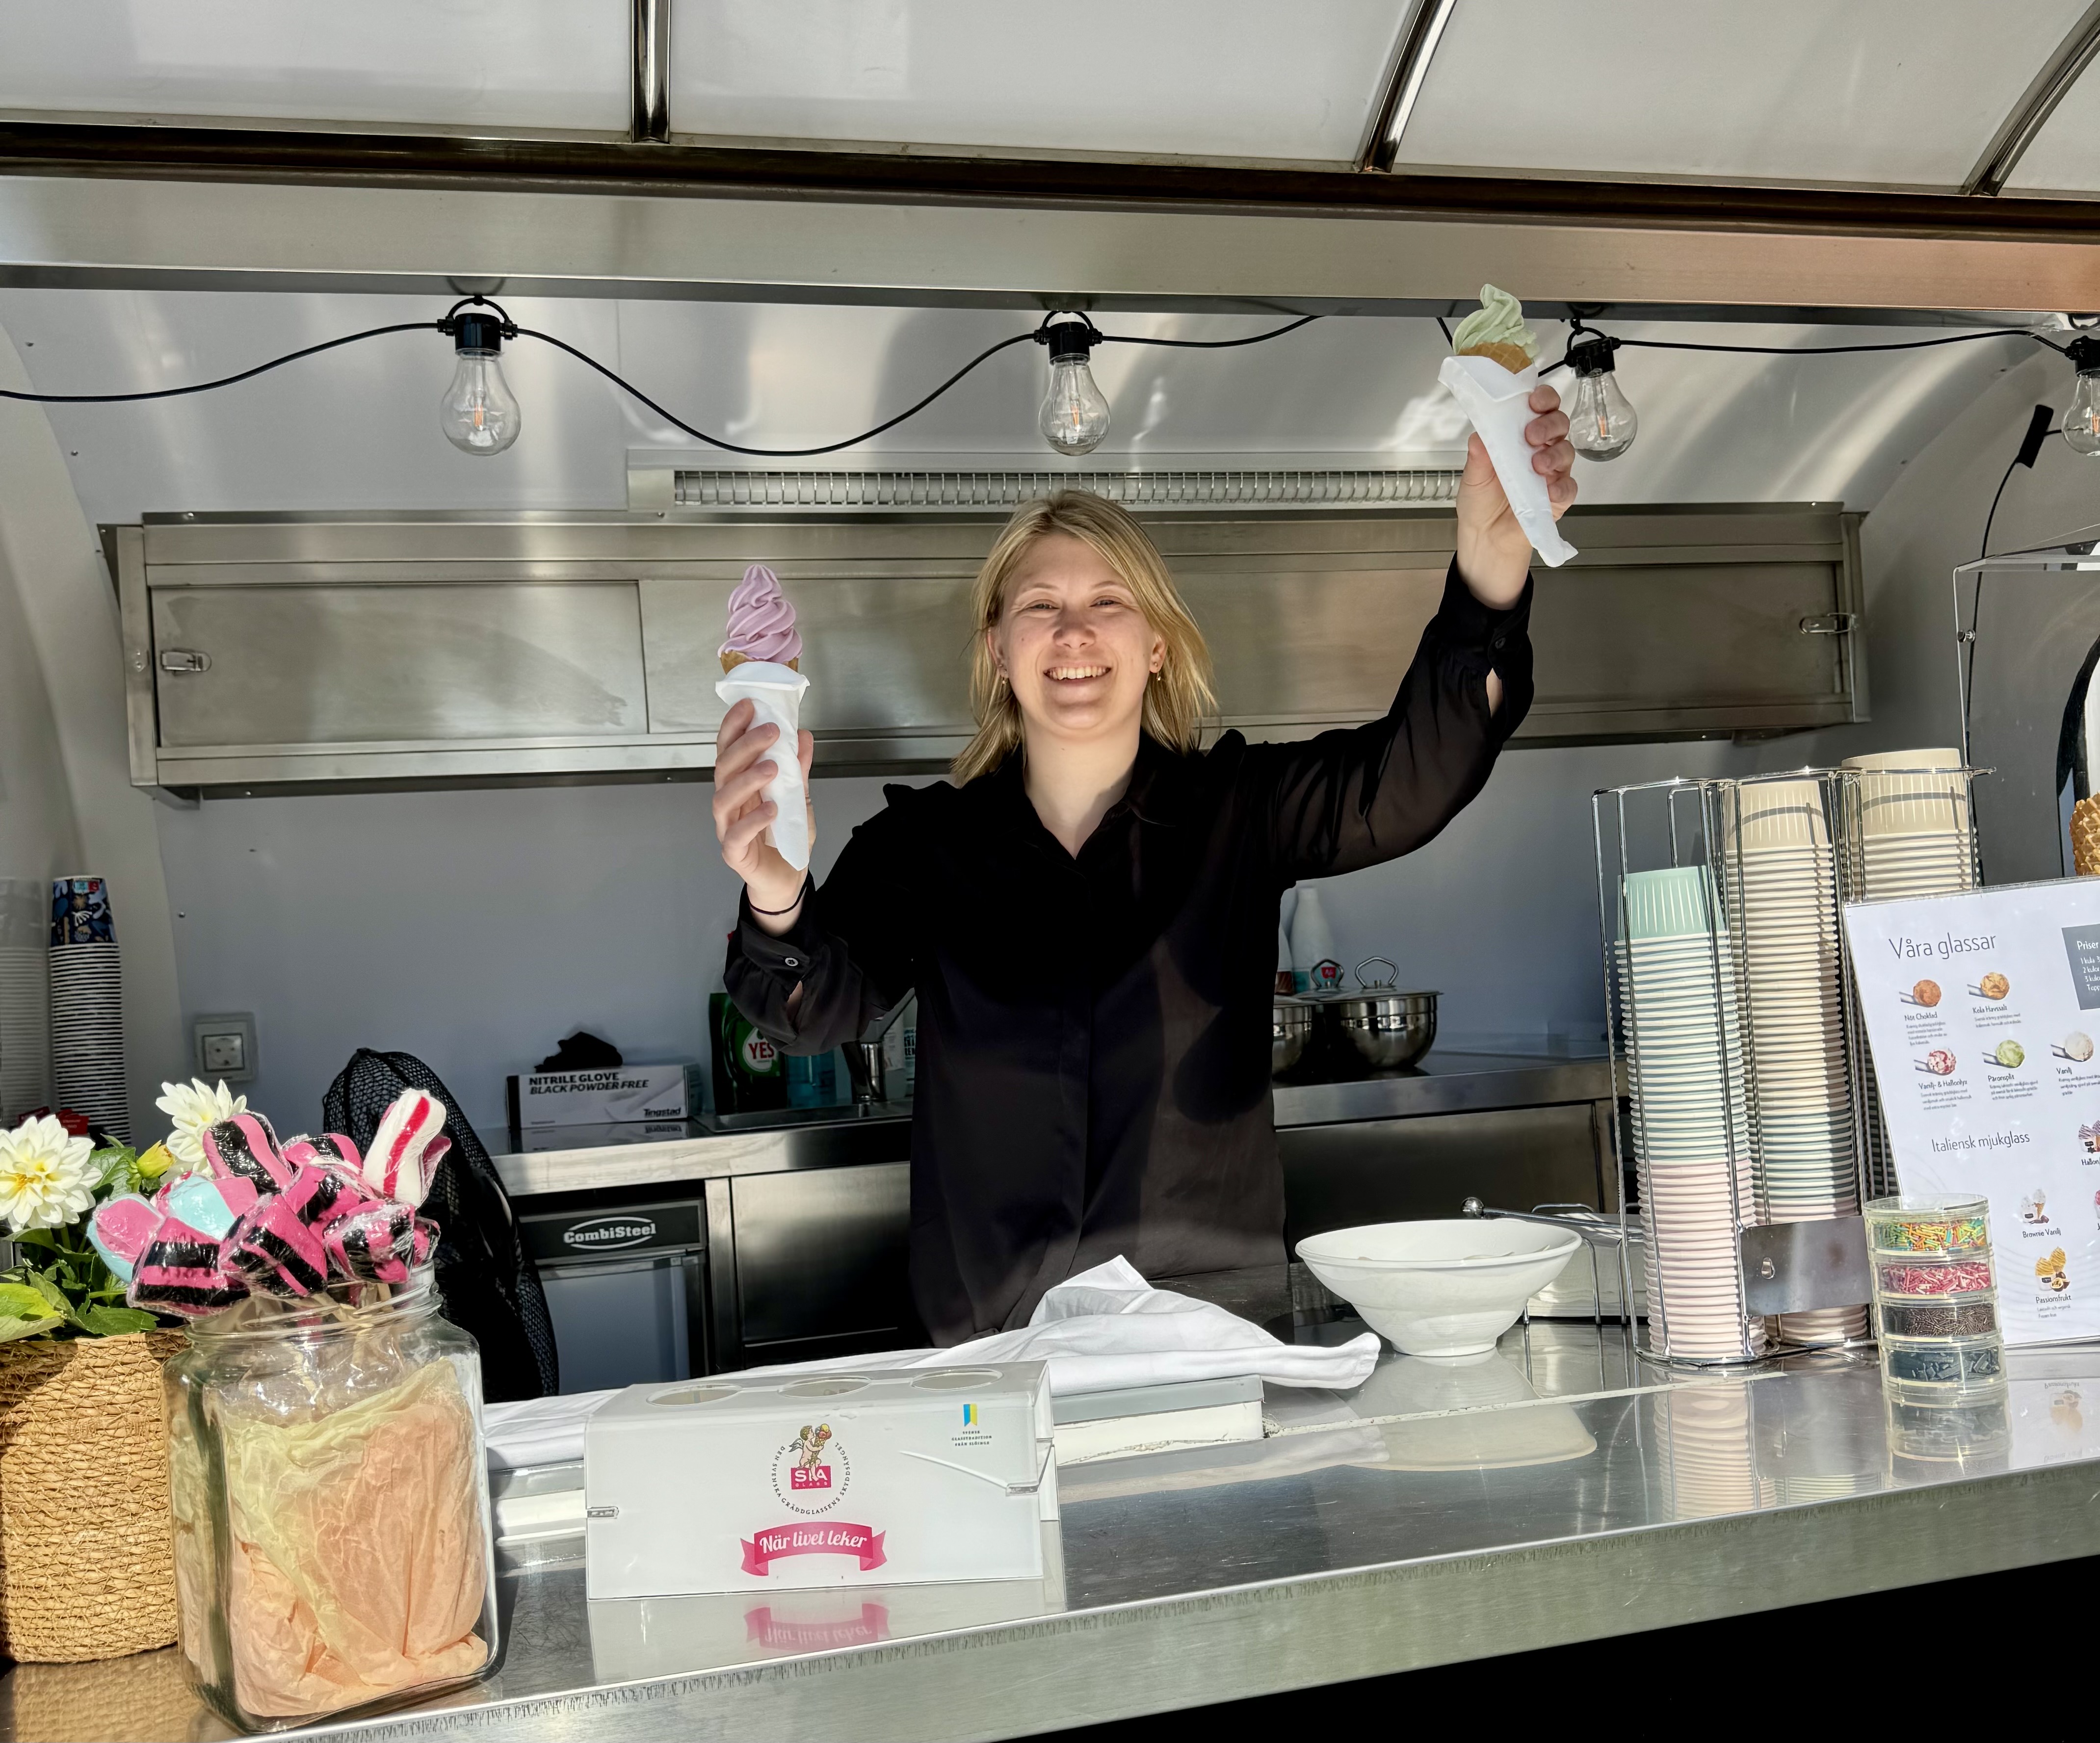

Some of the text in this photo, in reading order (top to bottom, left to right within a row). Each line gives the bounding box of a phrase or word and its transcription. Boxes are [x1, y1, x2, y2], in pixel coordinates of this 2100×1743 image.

[1889, 932, 1996, 960] Våra glassar
[2077, 940, 2099, 950] Priser
[748, 1042, 774, 1060] YES
[529, 1072, 620, 1086] NITRILE GLOVE
[530, 1079, 650, 1095] BLACK POWDER FREE
[643, 1107, 682, 1118] Tingstad
[1931, 1130, 2030, 1152] Italiensk mjukglass
[564, 1223, 656, 1244] CombiSteel
[2035, 1293, 2072, 1304] Passionsfrukt
[774, 1446, 786, 1461] DEN
[771, 1463, 782, 1498] SVENSKA
[781, 1497, 840, 1515] GRÄDDGLASSENS
[759, 1530, 867, 1554] När livet leker
